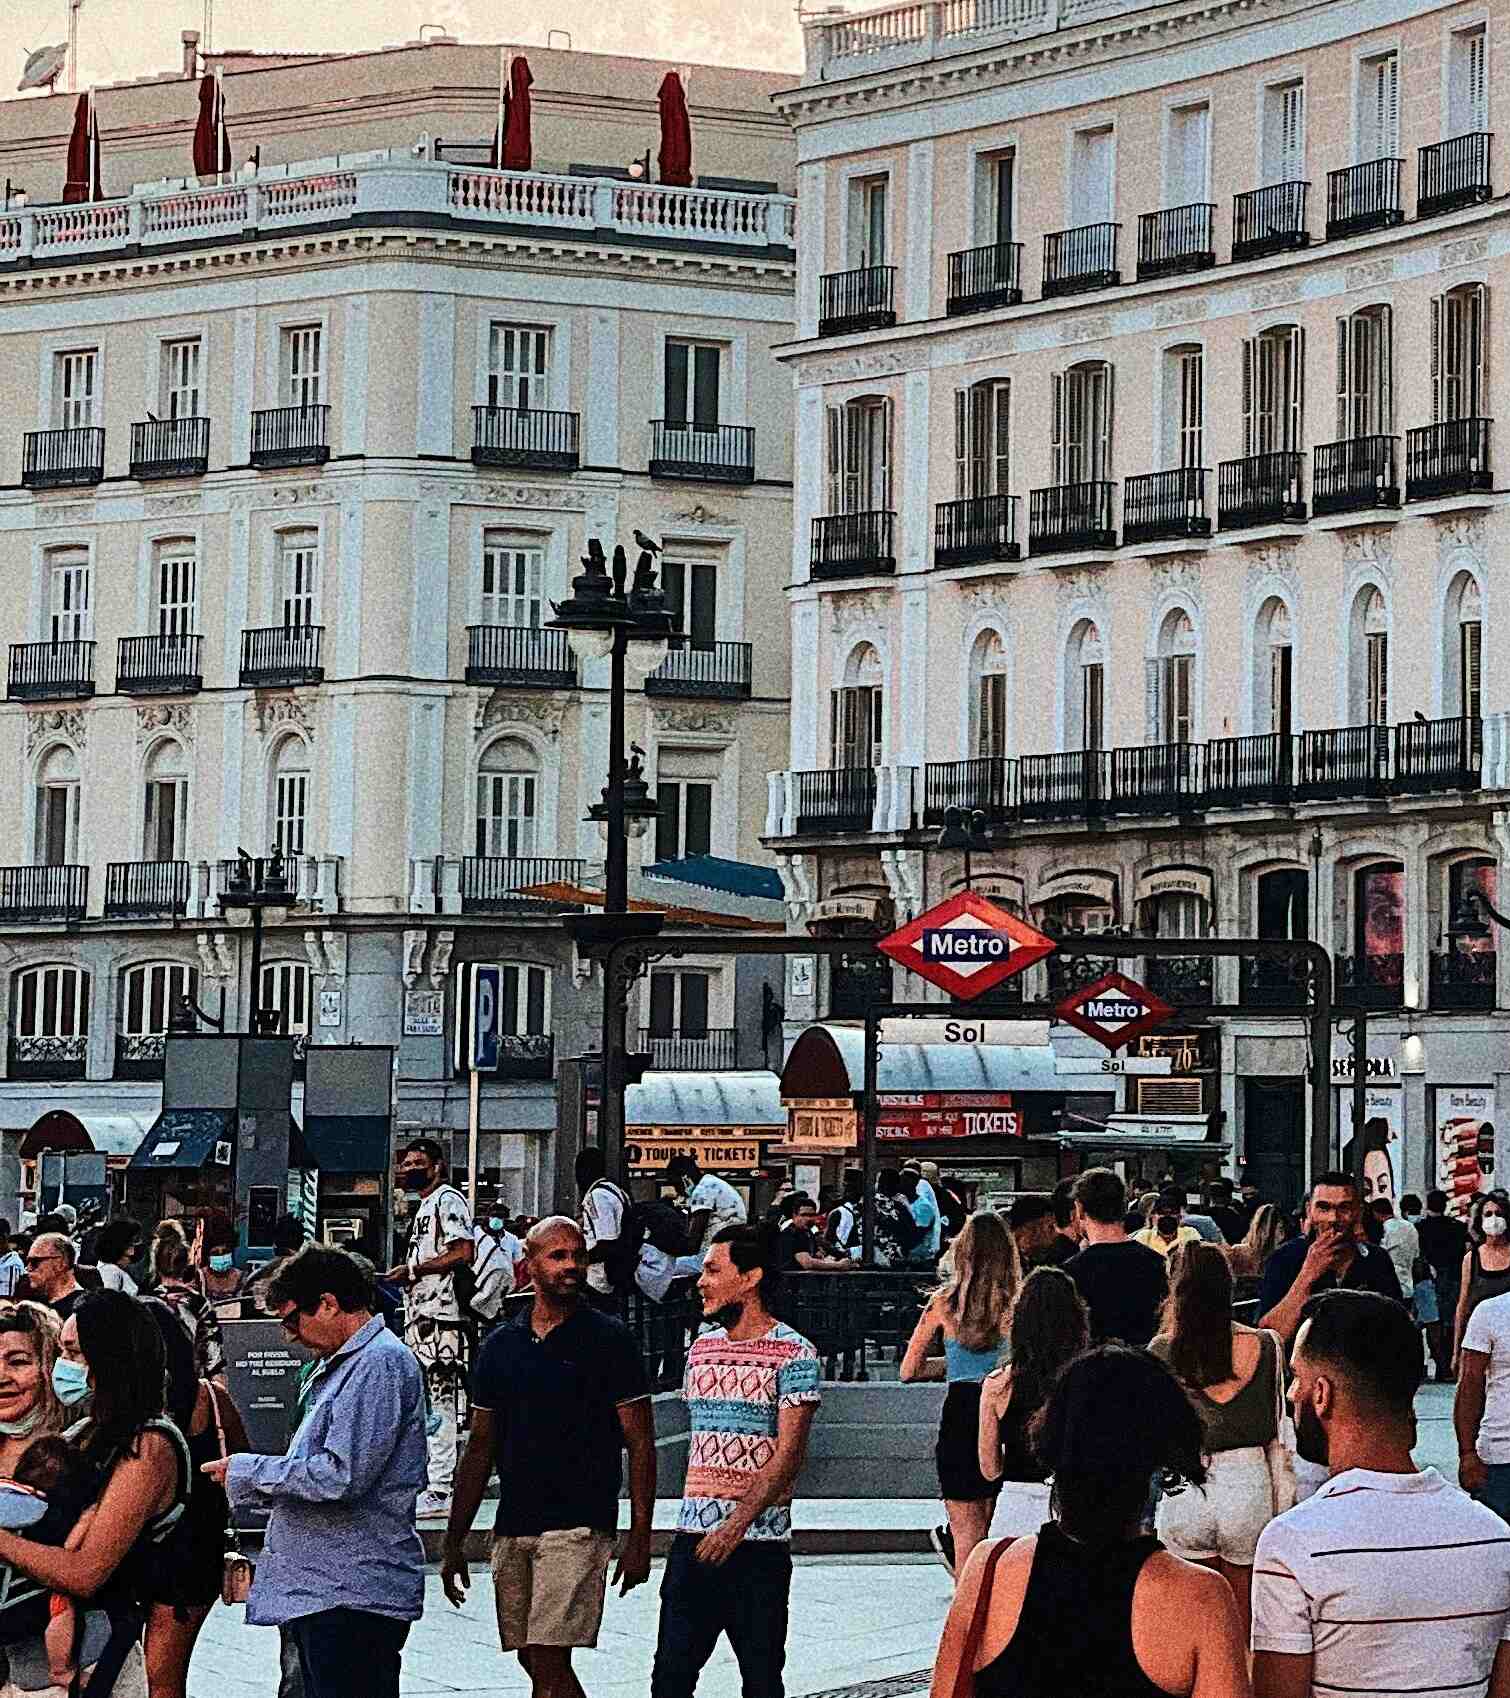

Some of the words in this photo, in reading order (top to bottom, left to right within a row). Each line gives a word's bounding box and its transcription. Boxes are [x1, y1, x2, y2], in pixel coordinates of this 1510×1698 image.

[931, 933, 1004, 956] Metro
[1087, 1002, 1139, 1018] Metro
[944, 1022, 985, 1043] Sol
[1101, 1059, 1125, 1072] Sol
[1332, 1057, 1394, 1077] SEPORA
[962, 1112, 1017, 1134] TICKETS
[645, 1147, 685, 1161] TOURS
[703, 1147, 756, 1161] TICKETS
